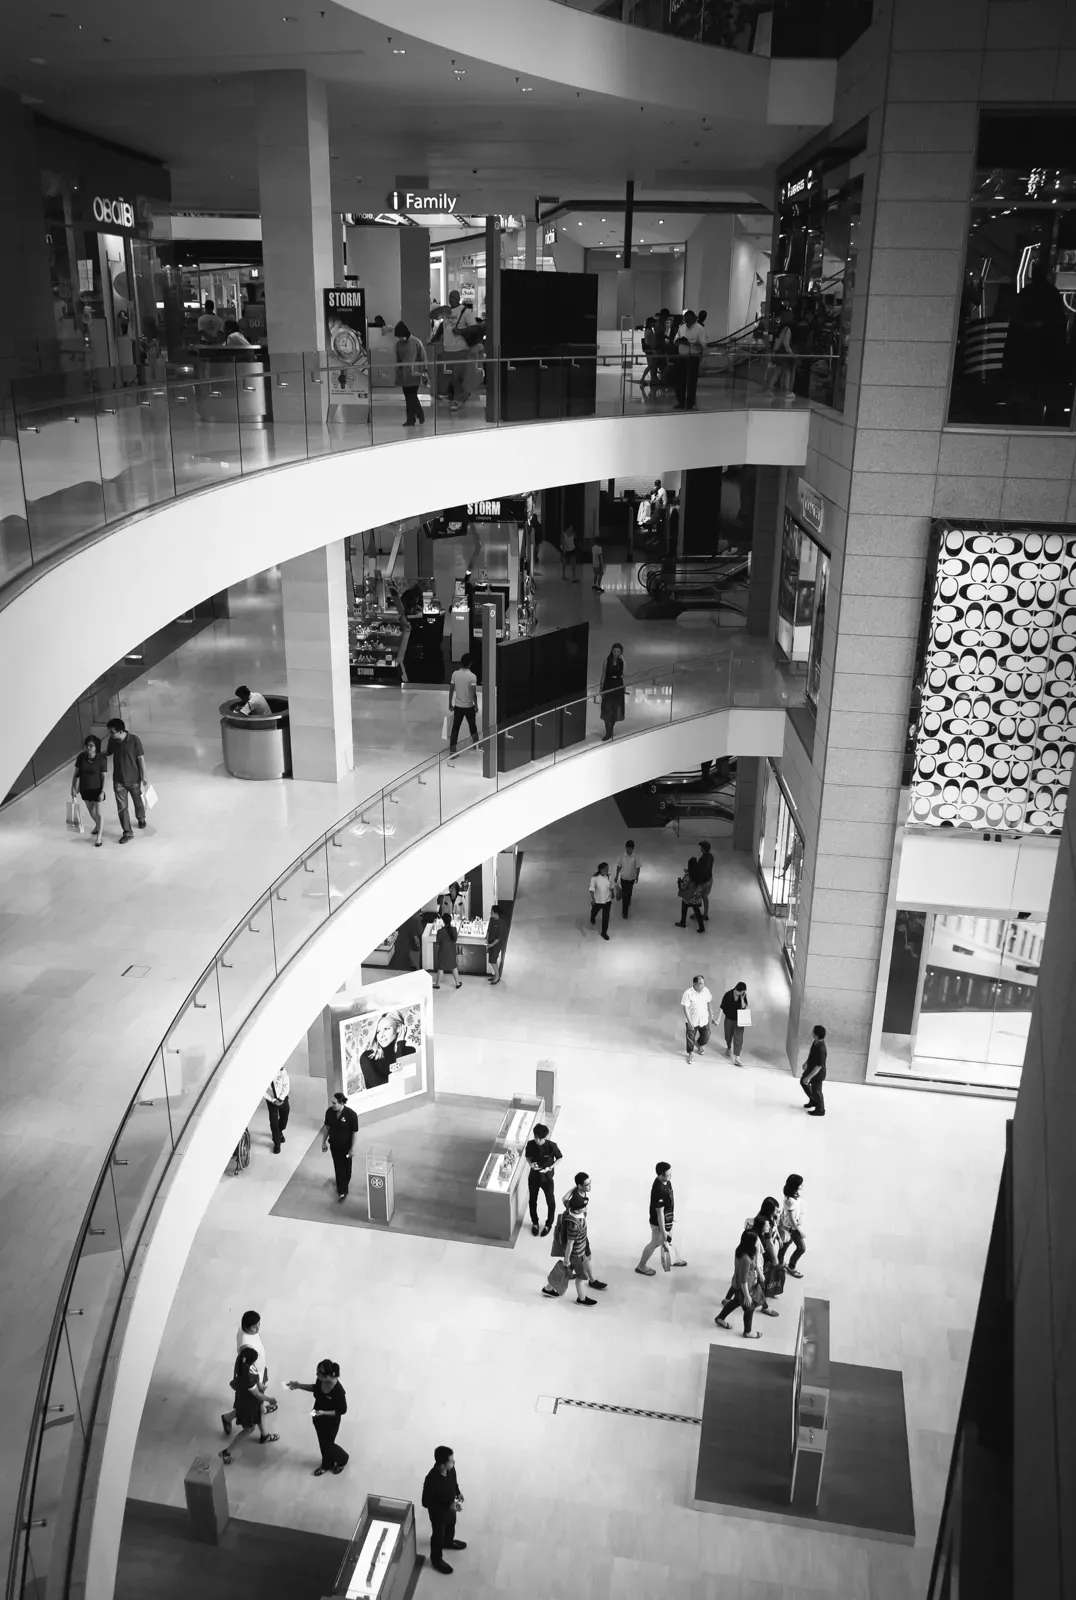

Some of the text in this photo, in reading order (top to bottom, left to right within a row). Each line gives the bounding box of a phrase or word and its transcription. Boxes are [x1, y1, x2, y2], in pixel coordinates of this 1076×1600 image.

[405, 192, 457, 213] Family
[328, 291, 361, 307] STORM
[466, 501, 501, 516] STORM
[650, 785, 657, 794] 3
[659, 801, 666, 810] 3
